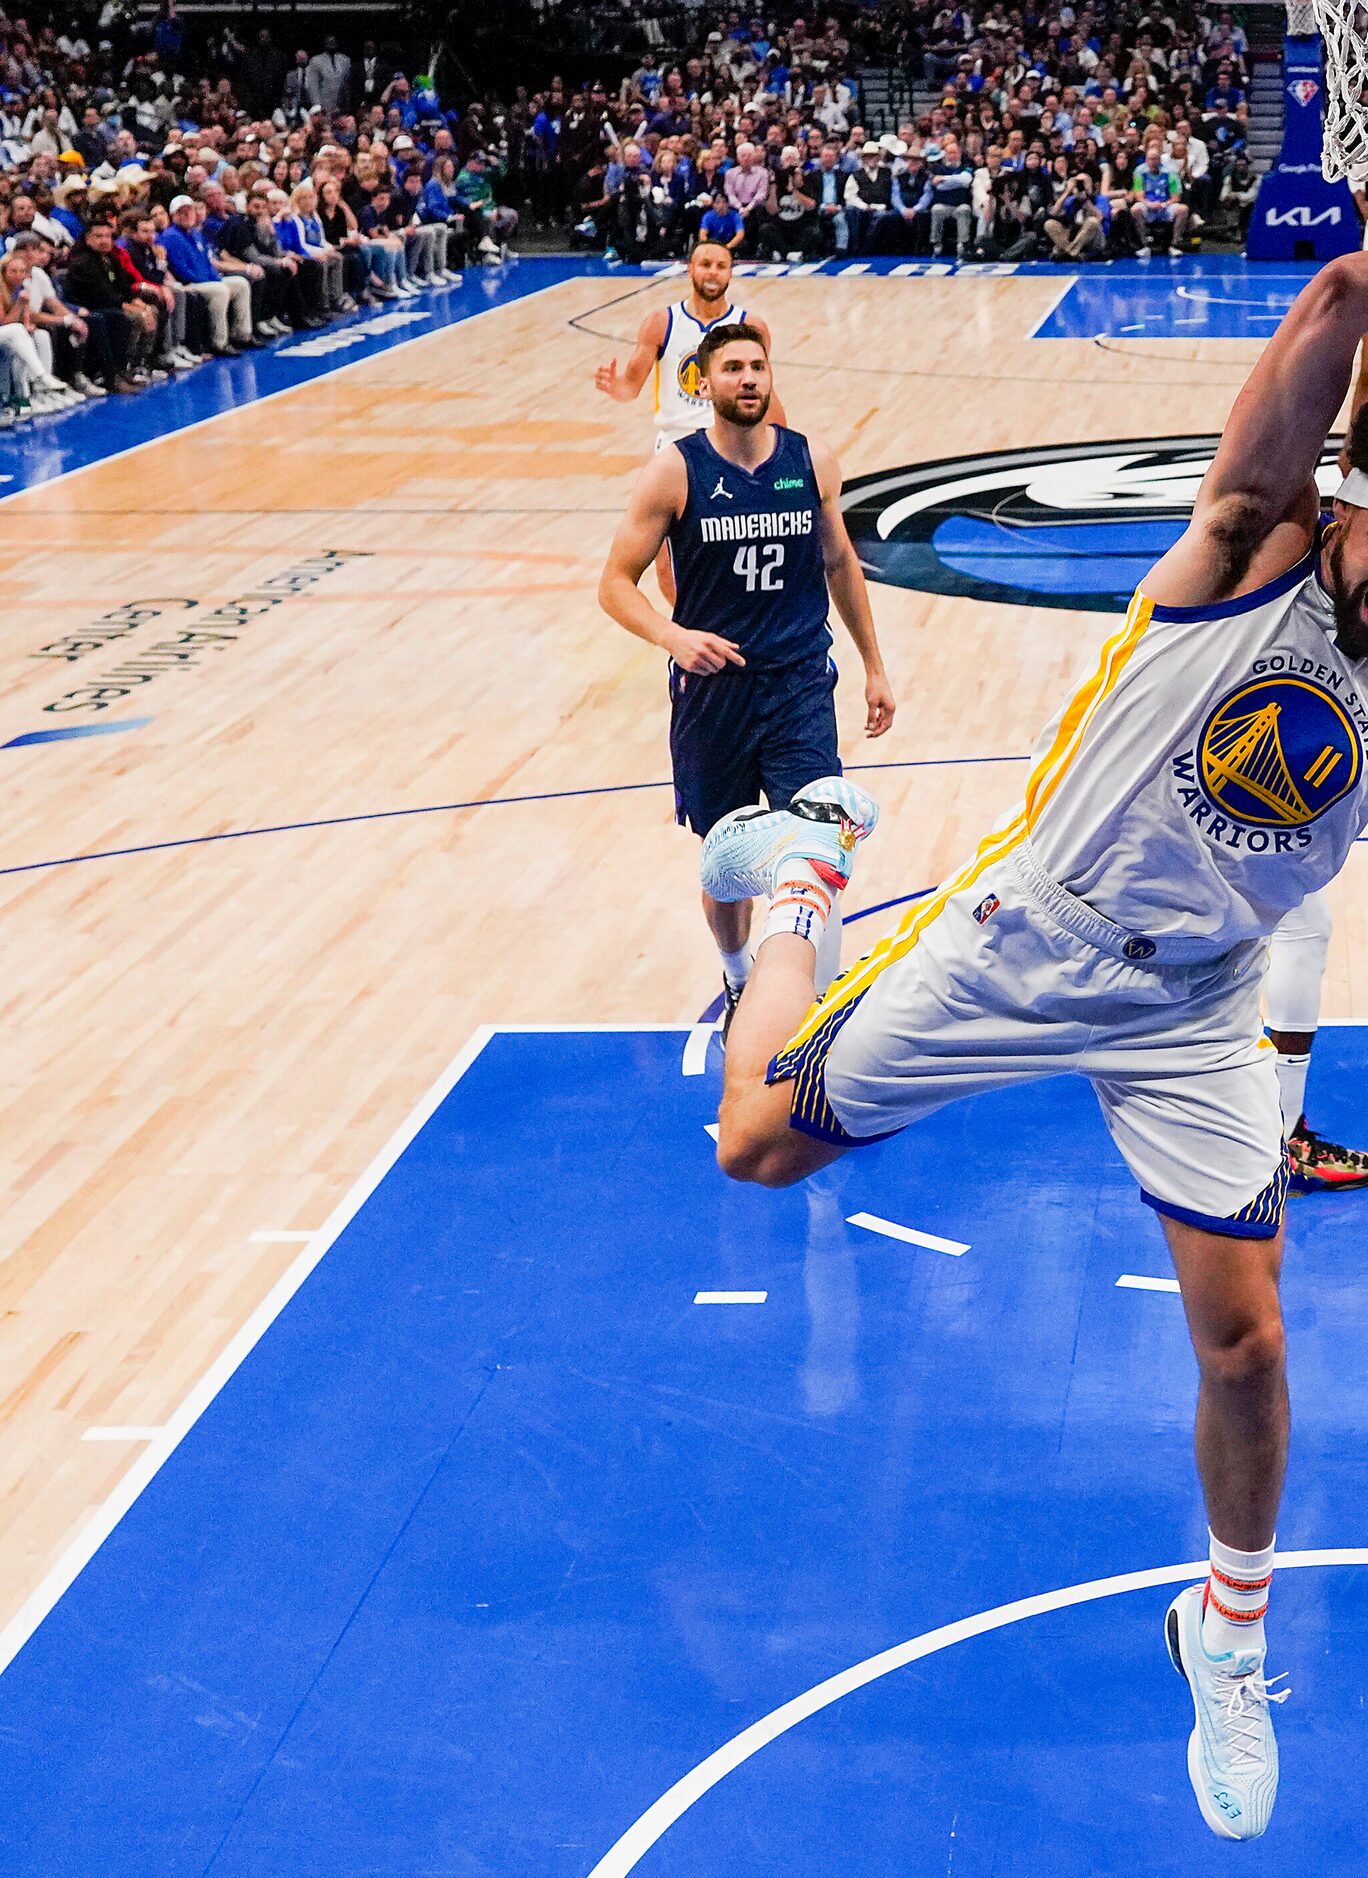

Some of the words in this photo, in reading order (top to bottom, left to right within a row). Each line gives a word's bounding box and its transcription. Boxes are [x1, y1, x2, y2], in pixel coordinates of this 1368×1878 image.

[773, 477, 804, 491] chime
[701, 510, 813, 543] MAVERICKS
[732, 543, 785, 592] 42
[1252, 655, 1345, 691] GOLDEN
[1303, 745, 1343, 788] 11
[1172, 748, 1313, 853] WARRIORS
